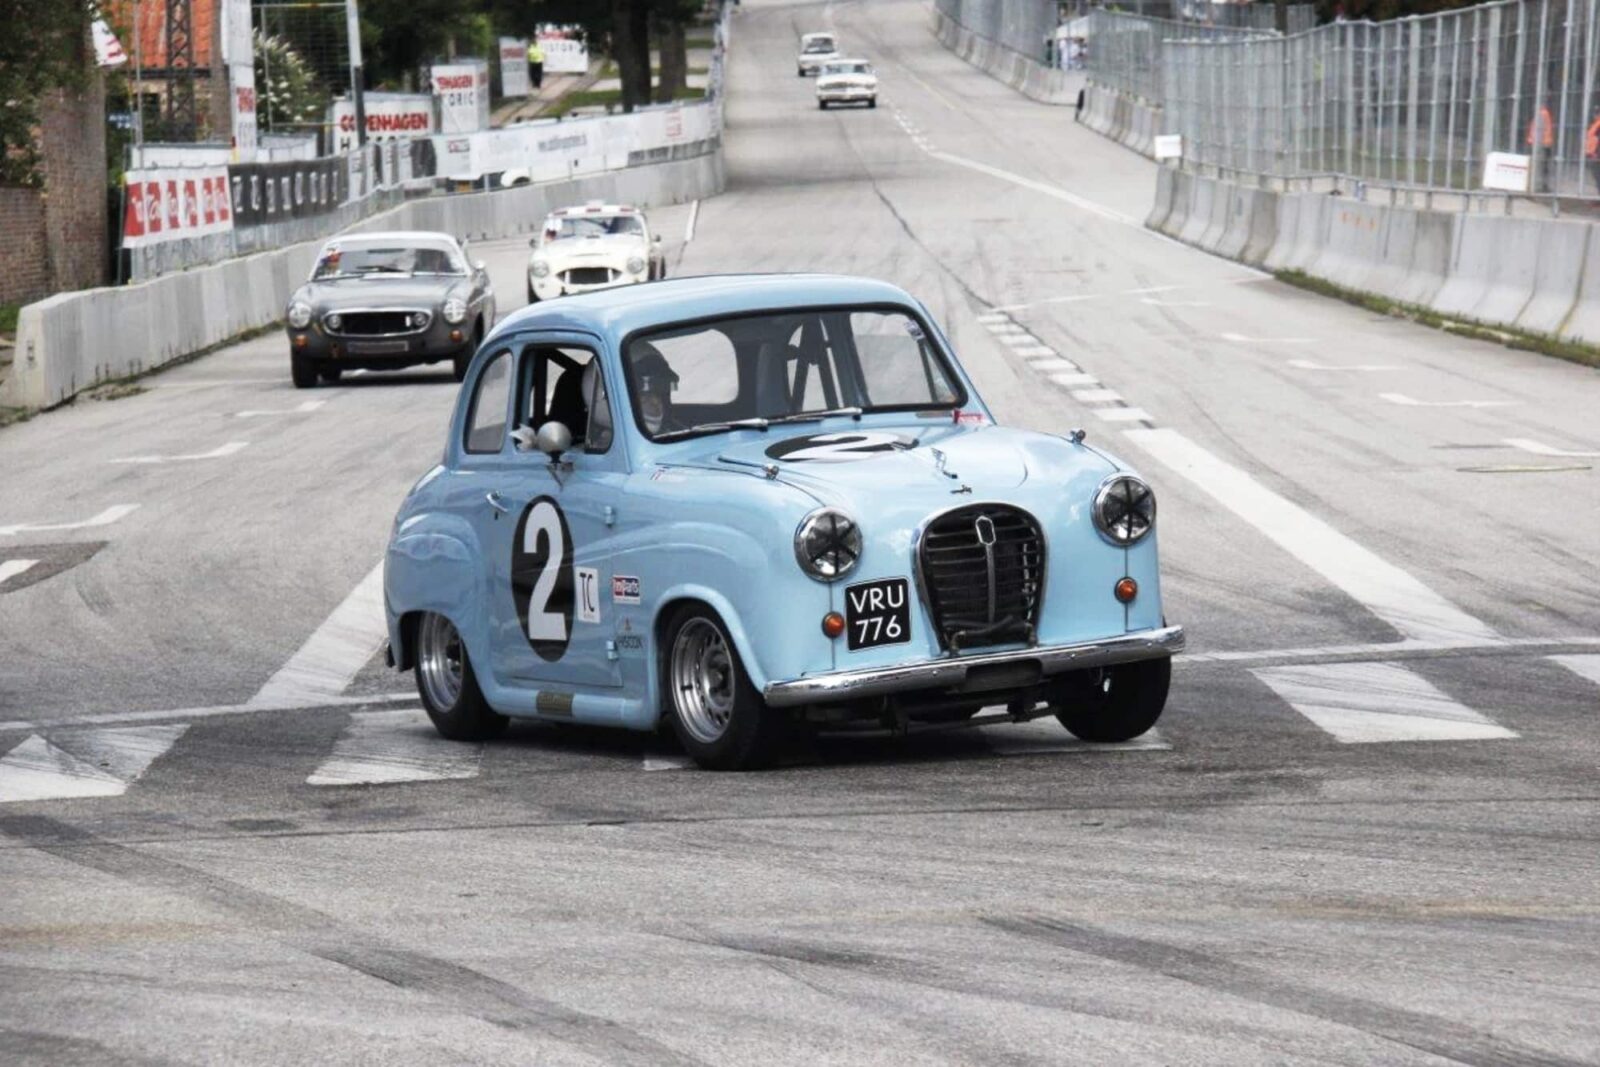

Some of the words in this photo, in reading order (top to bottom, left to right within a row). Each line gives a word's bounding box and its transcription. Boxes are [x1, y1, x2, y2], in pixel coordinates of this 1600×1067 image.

[779, 432, 900, 460] 2
[523, 502, 567, 641] 2
[579, 572, 595, 612] TC
[850, 585, 904, 613] VRU
[856, 615, 902, 643] 776
